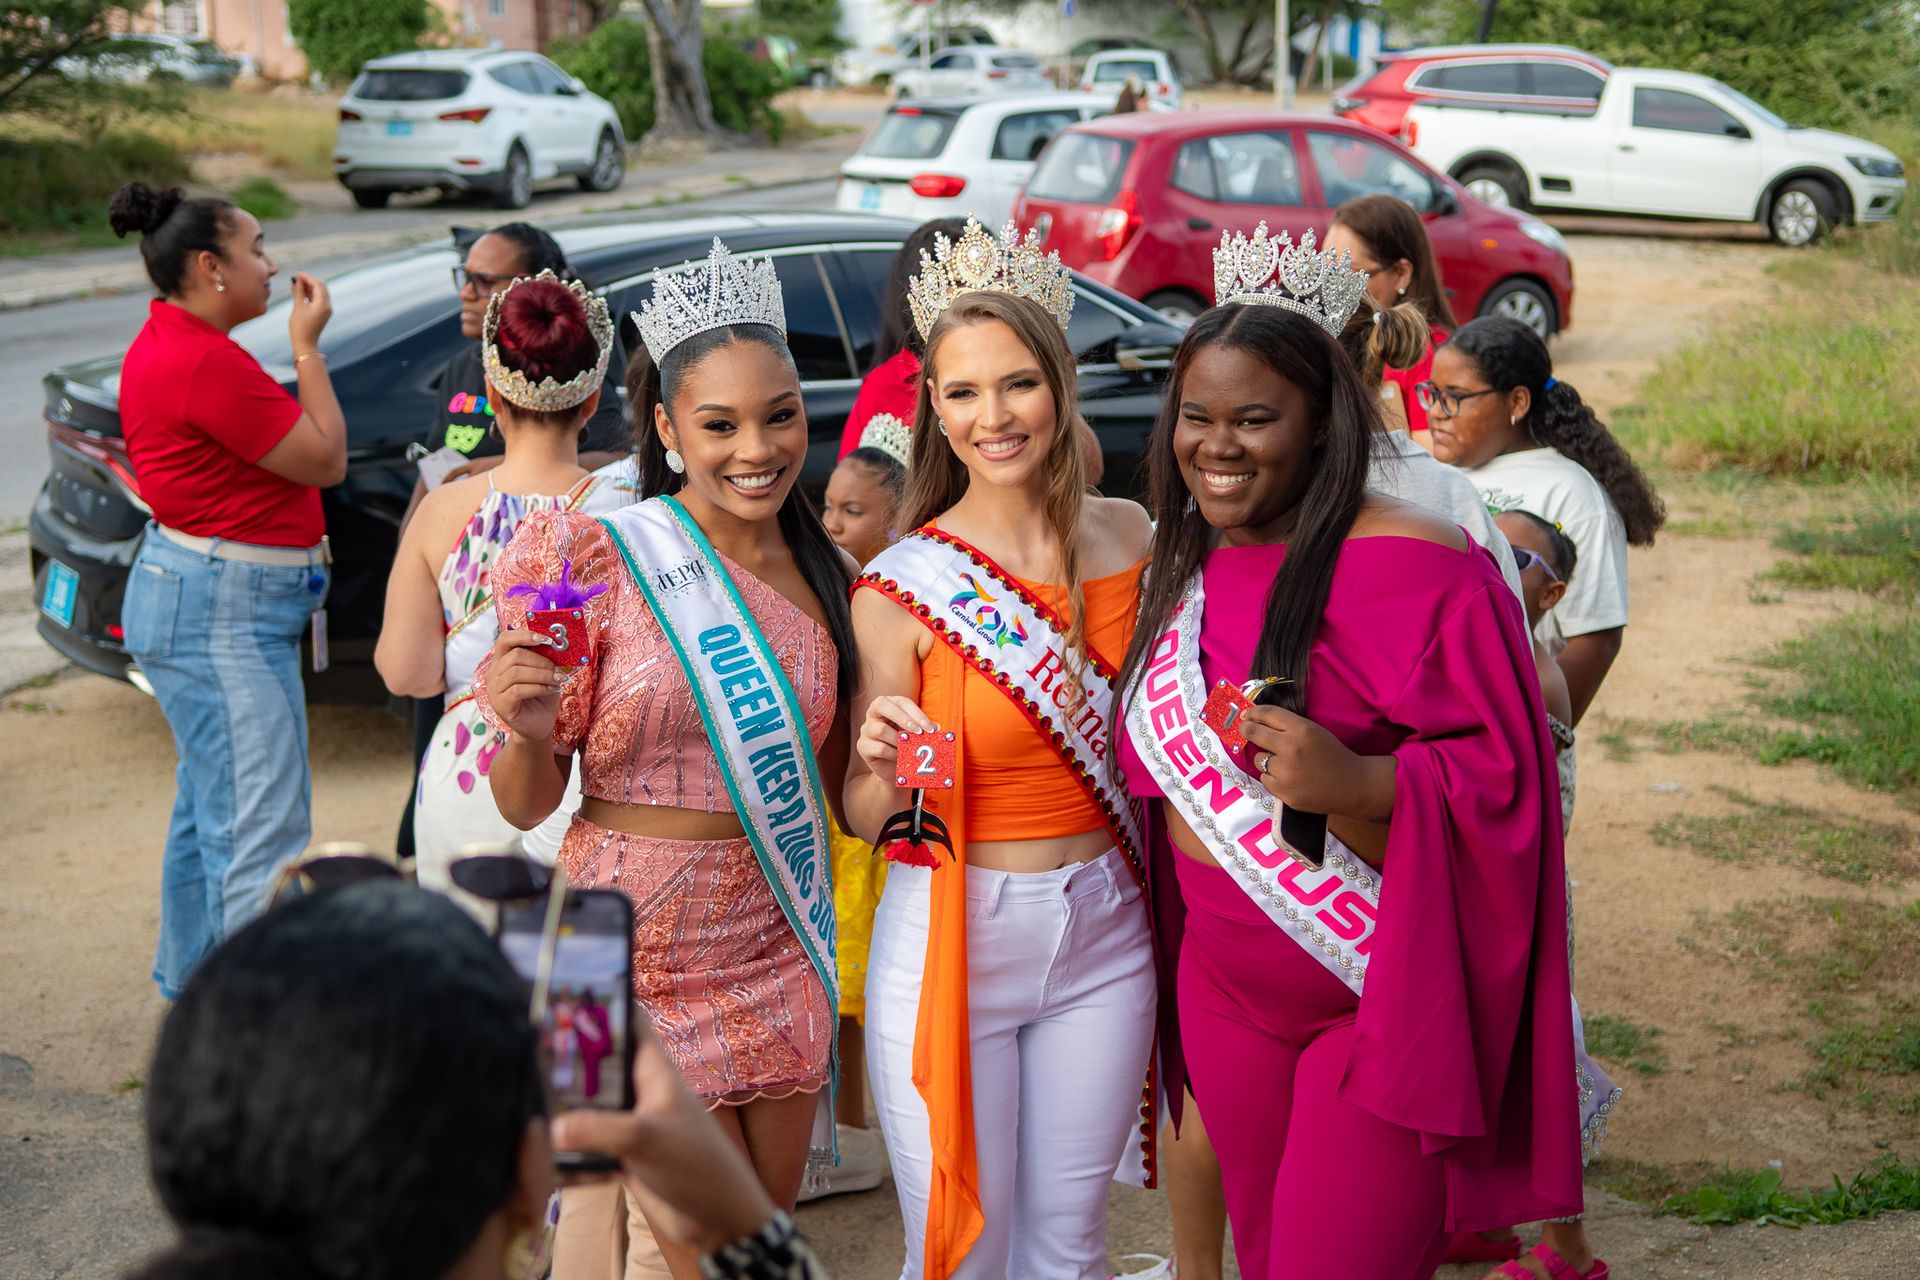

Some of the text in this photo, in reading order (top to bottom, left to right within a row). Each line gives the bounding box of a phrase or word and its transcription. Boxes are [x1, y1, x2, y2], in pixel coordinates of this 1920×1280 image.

[549, 622, 569, 651] 3
[951, 606, 996, 646] Carnival Group
[1026, 646, 1107, 760] Reina
[1144, 629, 1244, 815] QUEEN
[1224, 702, 1239, 729] 1
[698, 624, 785, 743] QUEEN
[748, 741, 807, 831] HEPA
[916, 745, 936, 775] 2
